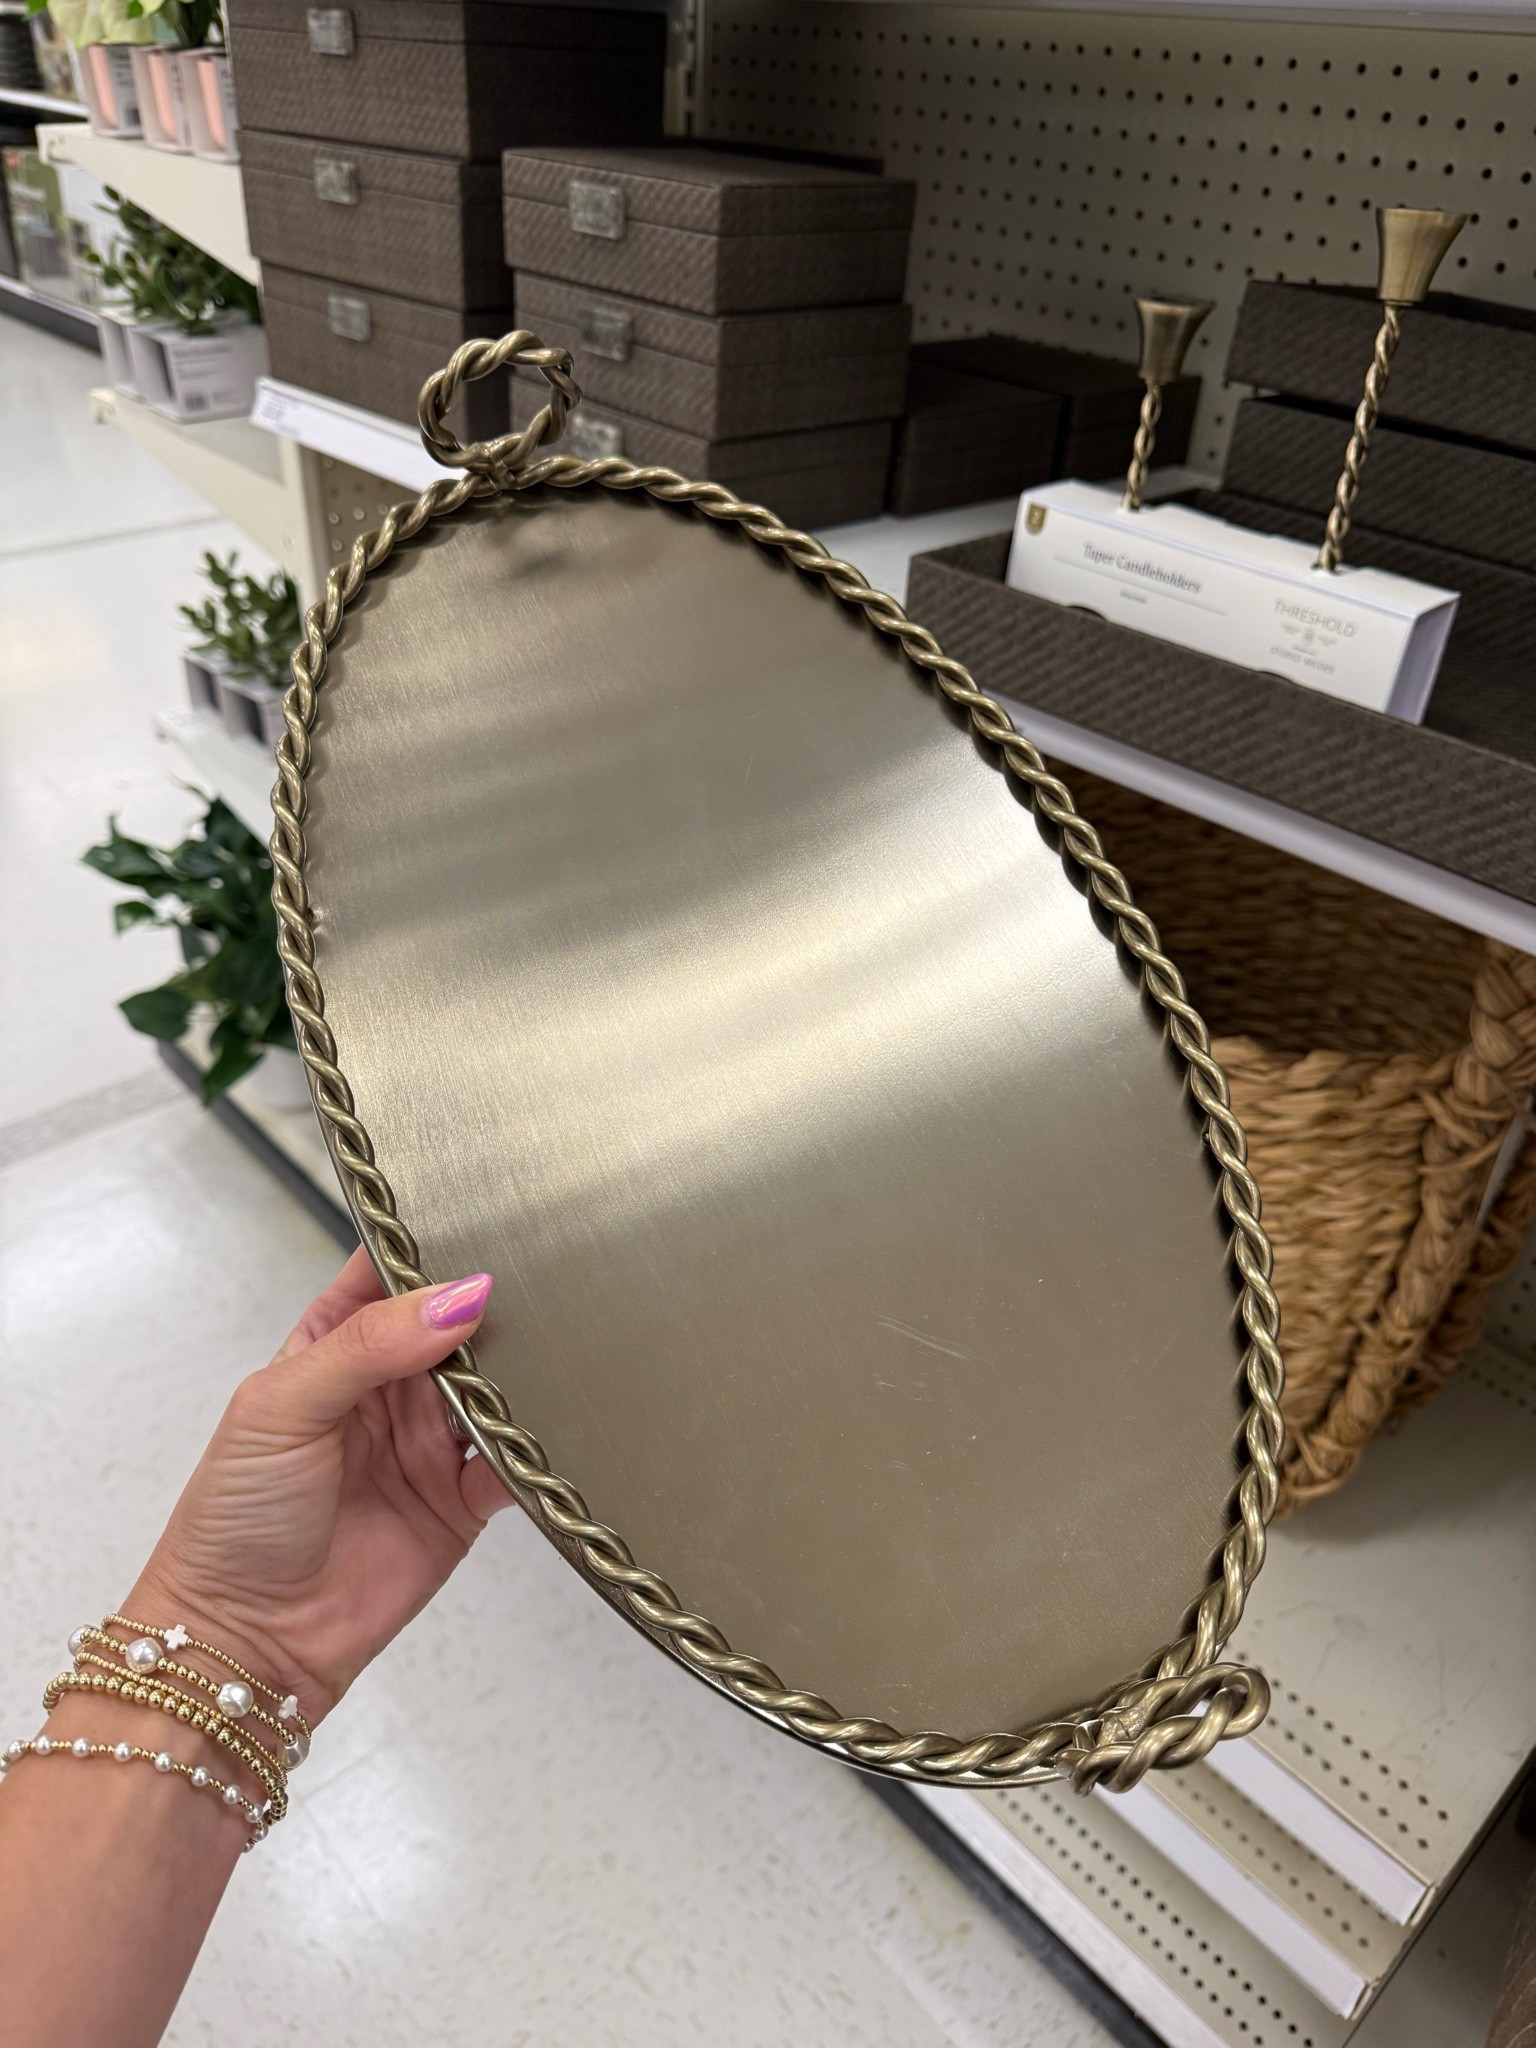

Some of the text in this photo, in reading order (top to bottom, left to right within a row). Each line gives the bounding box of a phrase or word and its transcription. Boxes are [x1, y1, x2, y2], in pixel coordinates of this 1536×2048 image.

[1084, 543, 1201, 593] Taper Candleholders
[1275, 601, 1356, 637] THRESHOLD
